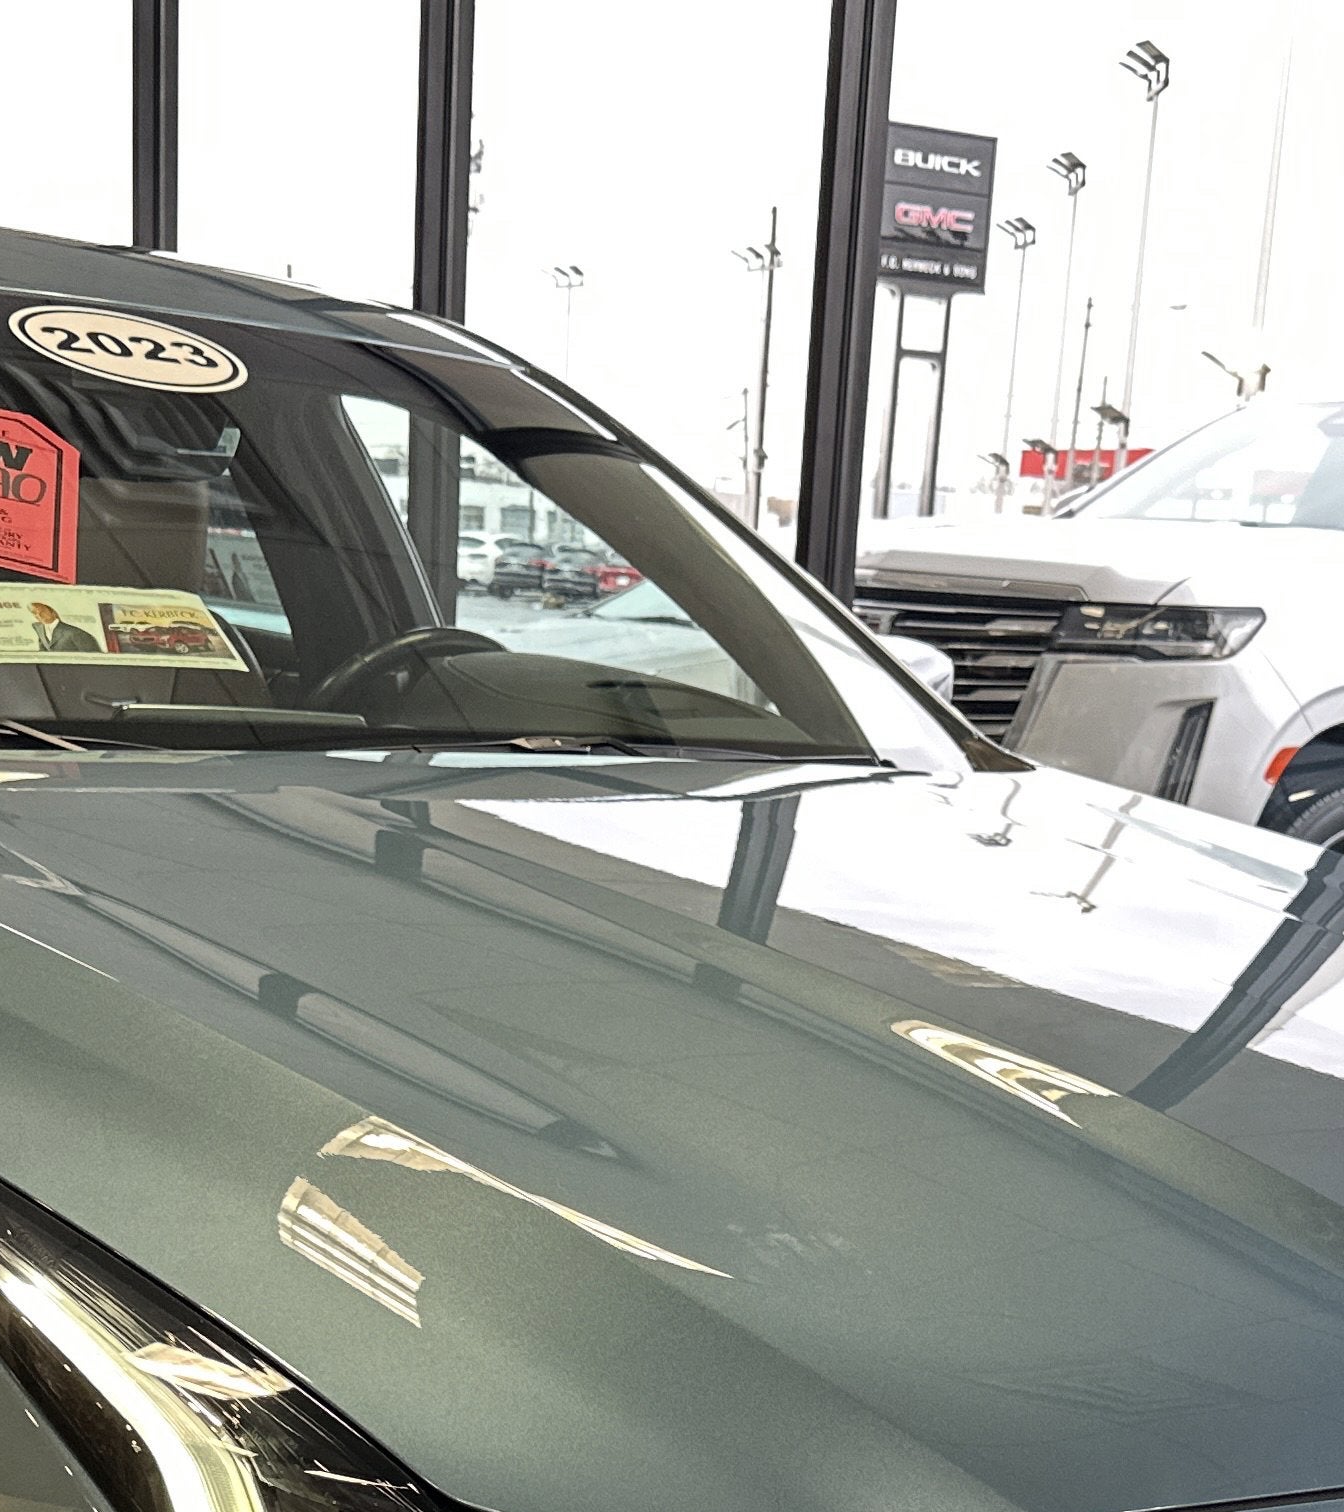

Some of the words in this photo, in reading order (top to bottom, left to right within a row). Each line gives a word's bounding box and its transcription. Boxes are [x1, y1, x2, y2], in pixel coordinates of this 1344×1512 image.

[893, 148, 982, 177] BUICK
[894, 202, 976, 233] GMC
[40, 326, 219, 369] 2023
